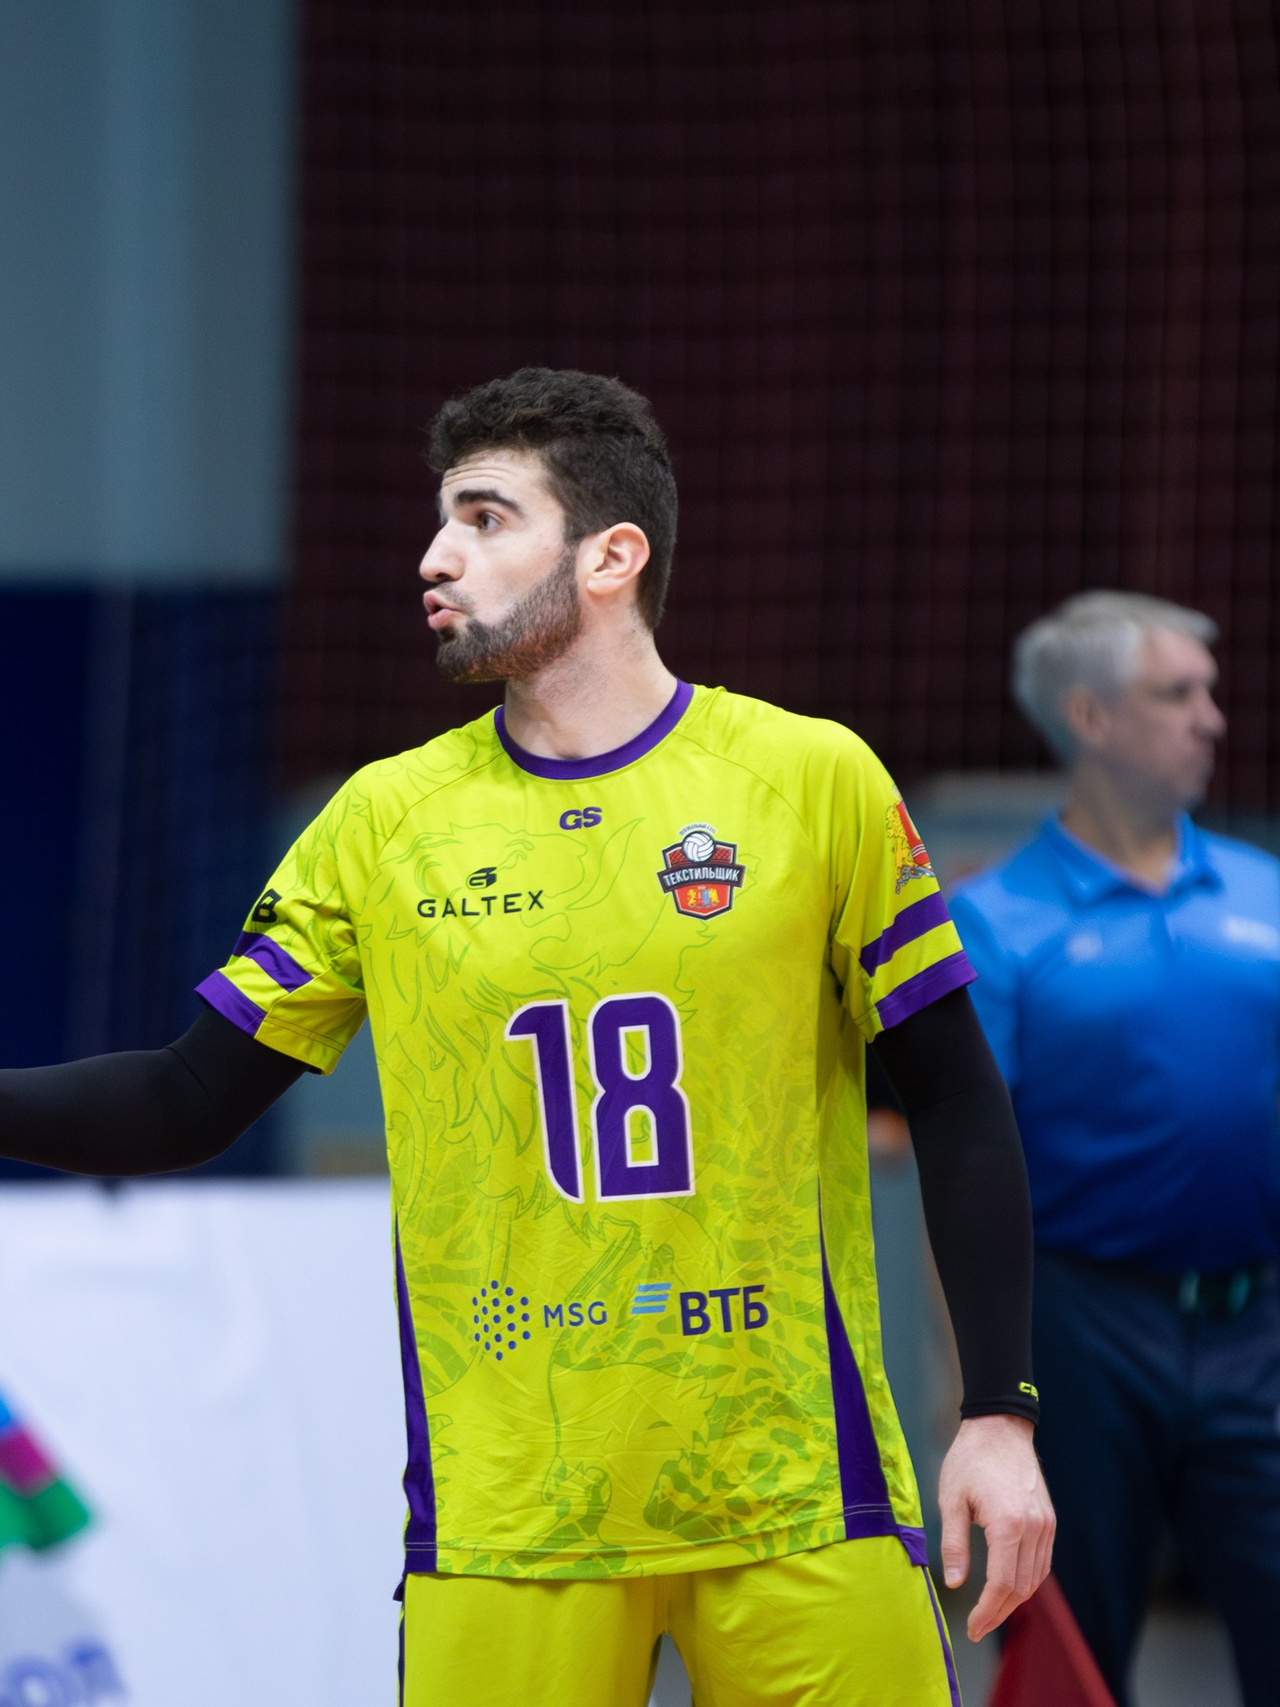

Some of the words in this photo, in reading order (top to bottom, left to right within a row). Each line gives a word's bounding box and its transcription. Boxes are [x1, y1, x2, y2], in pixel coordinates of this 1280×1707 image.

[559, 806, 603, 831] GS
[662, 867, 740, 887] ТЕКСТИЛЬЩИК
[417, 889, 544, 918] GALTEX
[504, 991, 696, 1204] 18
[543, 1301, 608, 1328] MSG
[679, 1284, 769, 1336] ВТБ
